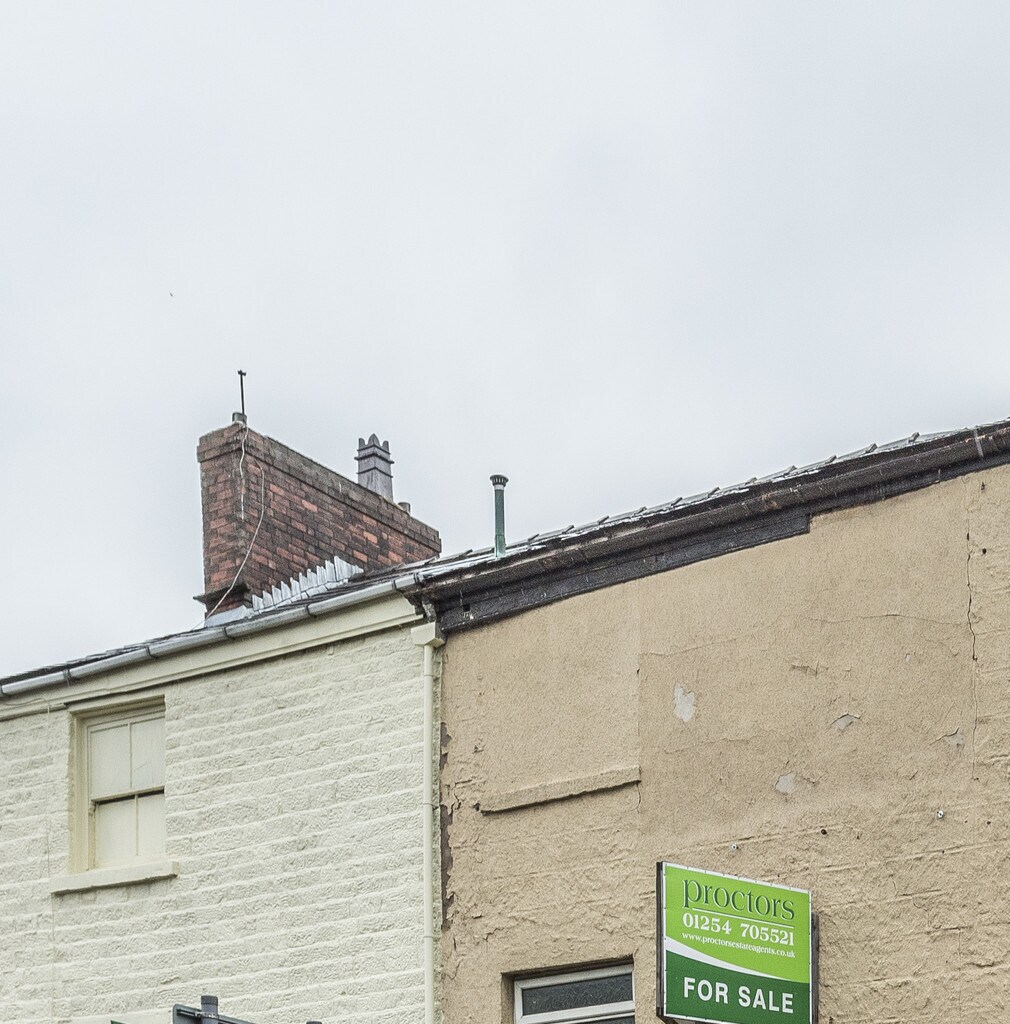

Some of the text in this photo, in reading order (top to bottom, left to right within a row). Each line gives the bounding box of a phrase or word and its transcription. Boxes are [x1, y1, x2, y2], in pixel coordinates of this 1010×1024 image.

[682, 879, 795, 921] proctors
[681, 932, 796, 958] www.proctorsestateagents.co.uk
[682, 912, 795, 946] 01254 705521
[683, 976, 794, 1014] FOR SALE
